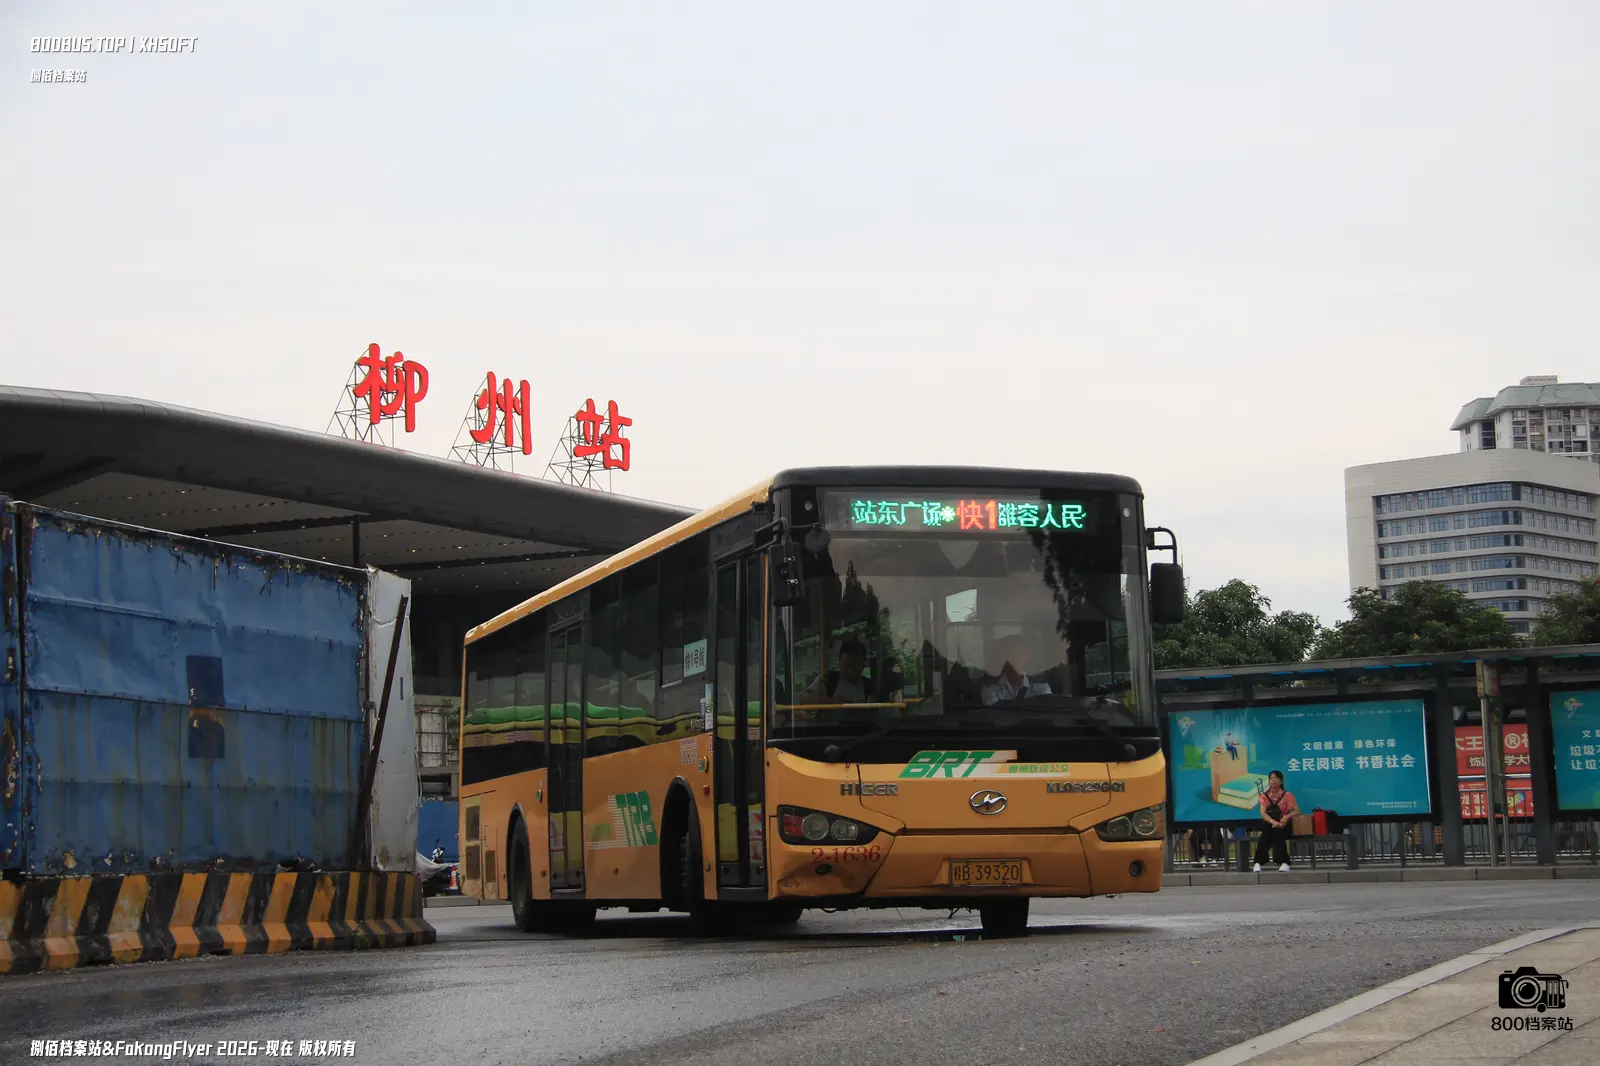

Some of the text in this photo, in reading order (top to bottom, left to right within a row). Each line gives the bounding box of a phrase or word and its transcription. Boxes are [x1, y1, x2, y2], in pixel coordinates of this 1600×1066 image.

[353, 343, 632, 471] 柳州站
[1303, 739, 1396, 751] 文明健康 绿色环保
[898, 751, 995, 778] BRT
[1287, 754, 1415, 772] 全民阅读 书香社会
[1571, 760, 1600, 770] 让垃
[840, 783, 898, 796] HIGER
[811, 845, 881, 864] 2-1636
